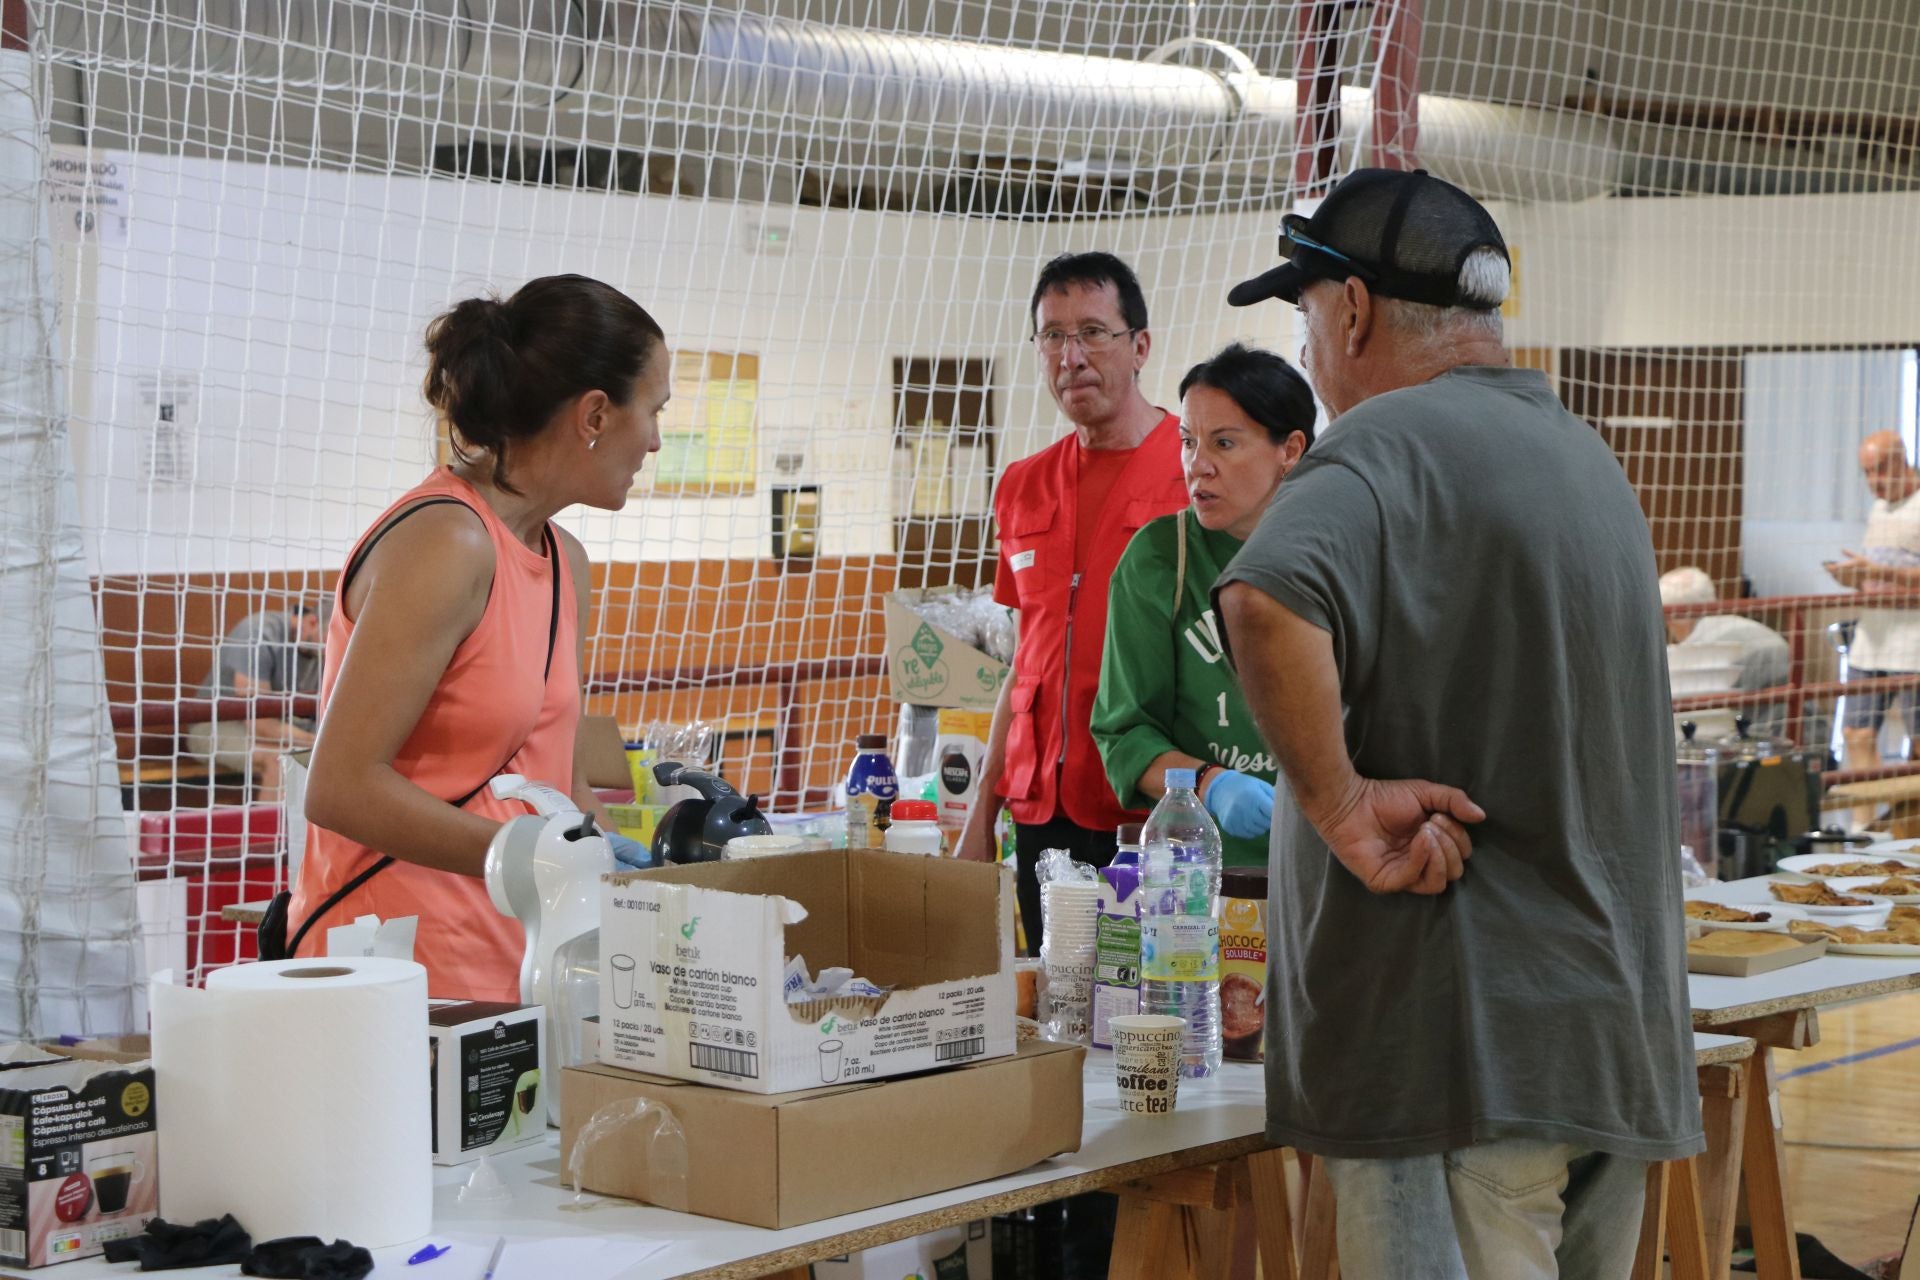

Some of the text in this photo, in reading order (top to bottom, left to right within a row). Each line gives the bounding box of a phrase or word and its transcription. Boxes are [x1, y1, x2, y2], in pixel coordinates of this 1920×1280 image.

[1216, 691, 1229, 727] 1
[650, 961, 757, 987] Vaso de cartón blanco
[720, 984, 732, 993] cup
[880, 1014, 891, 1025] de
[892, 1011, 918, 1023] cartón
[918, 1007, 945, 1020] blanco
[621, 1020, 640, 1031] packs
[1112, 1029, 1180, 1045] appuccino
[32, 1097, 106, 1116] Cápsulas de café
[1145, 1095, 1168, 1113] tea
[32, 1109, 93, 1127] Kafe-kapsulak
[74, 1120, 87, 1129] de
[32, 1121, 149, 1148] Espresso intenso descafeinado
[38, 1164, 48, 1176] 8
